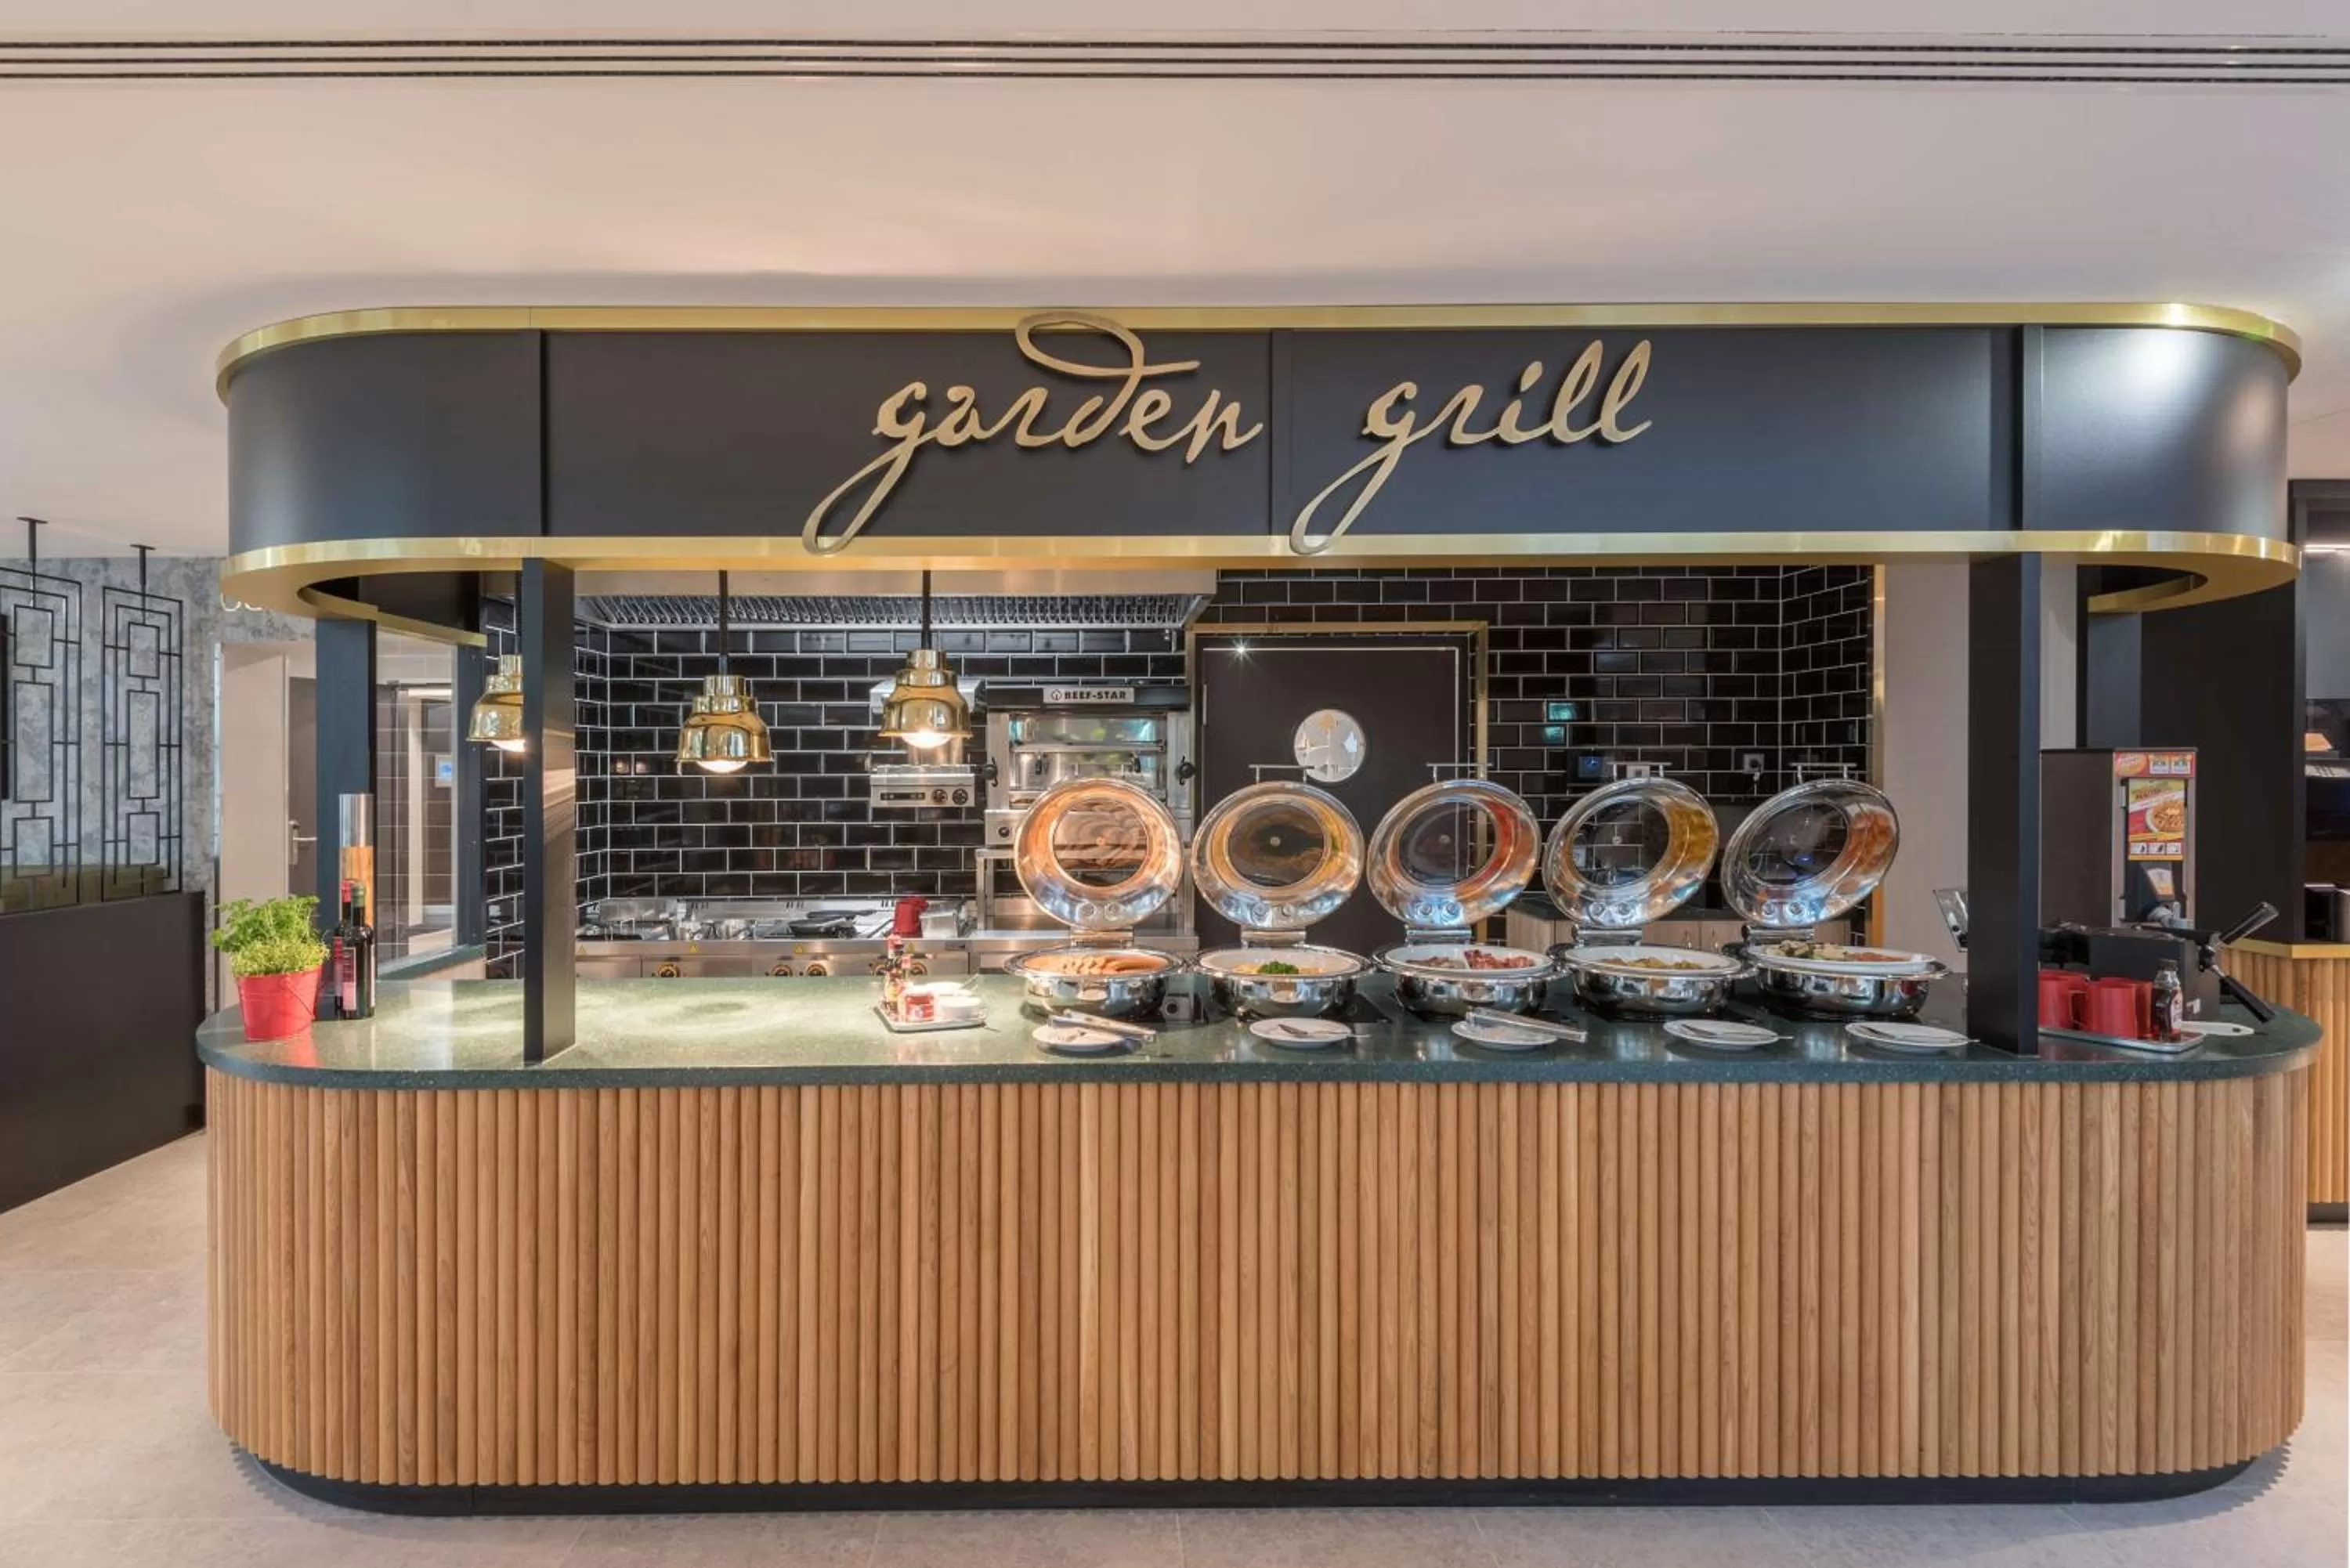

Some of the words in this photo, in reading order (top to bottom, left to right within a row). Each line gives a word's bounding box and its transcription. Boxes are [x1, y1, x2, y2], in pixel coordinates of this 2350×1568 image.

[802, 311, 1264, 555] garden
[1289, 338, 1653, 556] grill
[1065, 691, 1126, 699] BEEF-STAR
